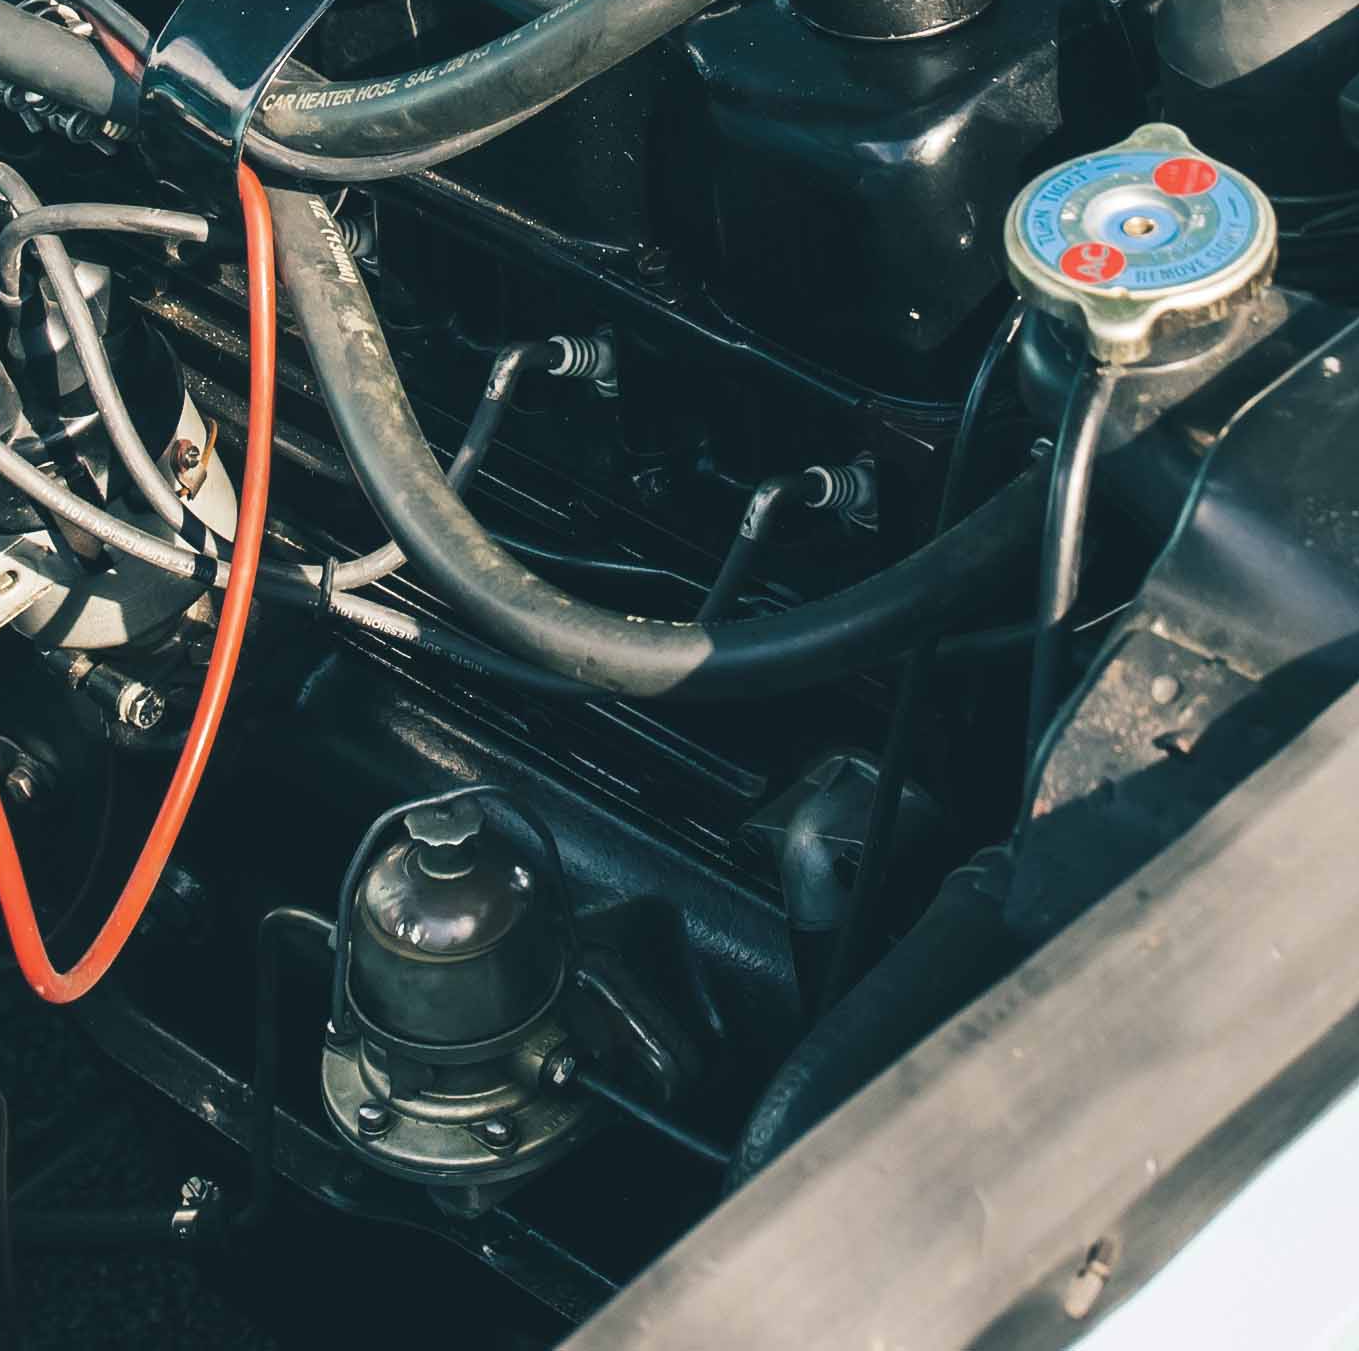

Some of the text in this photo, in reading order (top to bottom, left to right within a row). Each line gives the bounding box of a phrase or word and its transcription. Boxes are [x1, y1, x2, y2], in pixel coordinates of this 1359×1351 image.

[262, 94, 295, 111] CAR
[296, 88, 355, 110] HEATER
[355, 78, 400, 103] HOSE
[404, 67, 439, 89] SAE
[1076, 244, 1110, 281] AC
[1135, 259, 1207, 284] REMOVE
